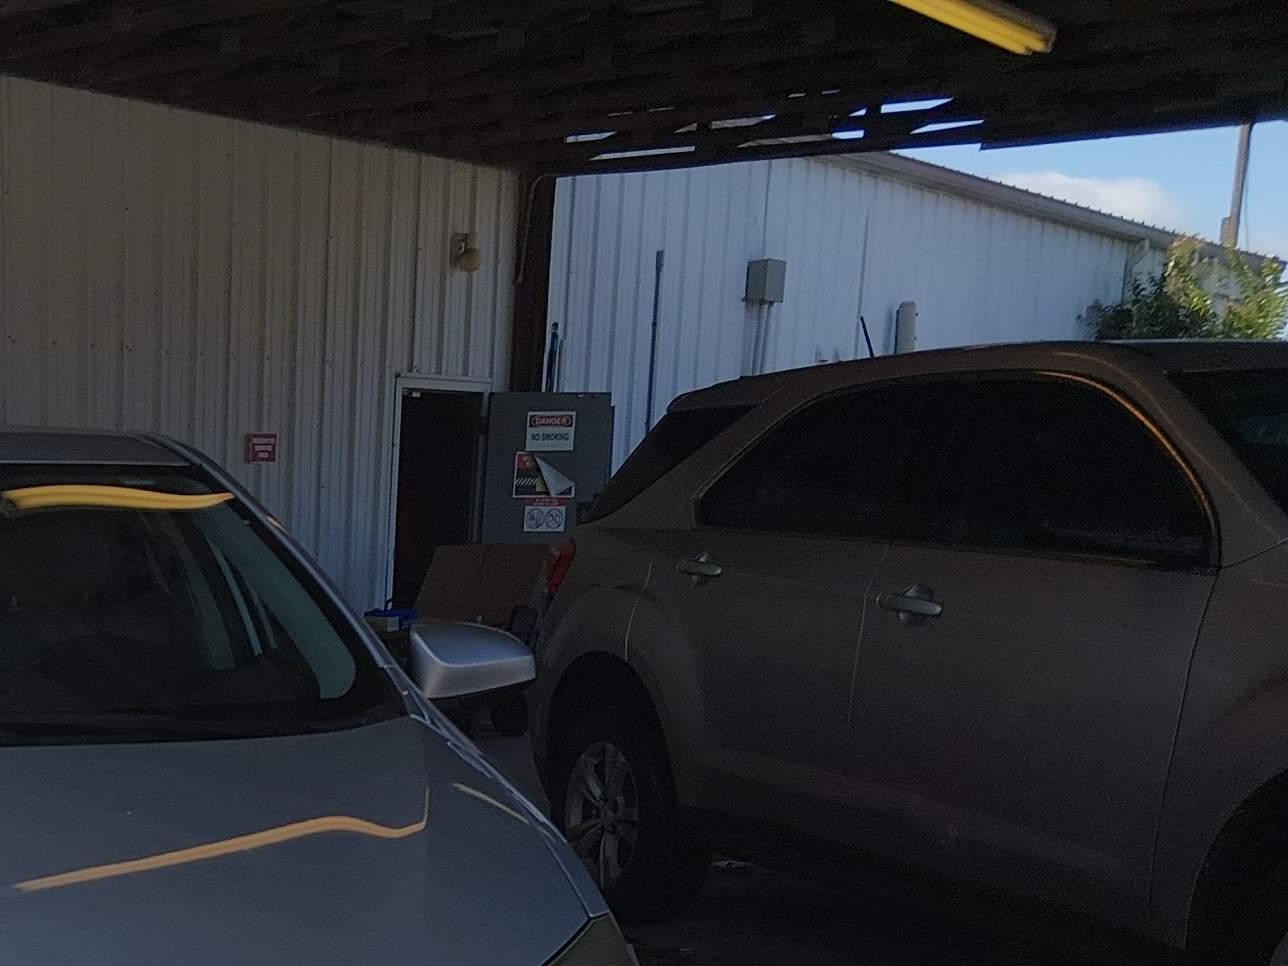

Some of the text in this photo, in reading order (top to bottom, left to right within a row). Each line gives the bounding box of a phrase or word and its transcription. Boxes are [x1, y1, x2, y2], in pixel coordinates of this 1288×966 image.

[535, 415, 568, 425] DANGER
[531, 433, 569, 442] NO SMOKING
